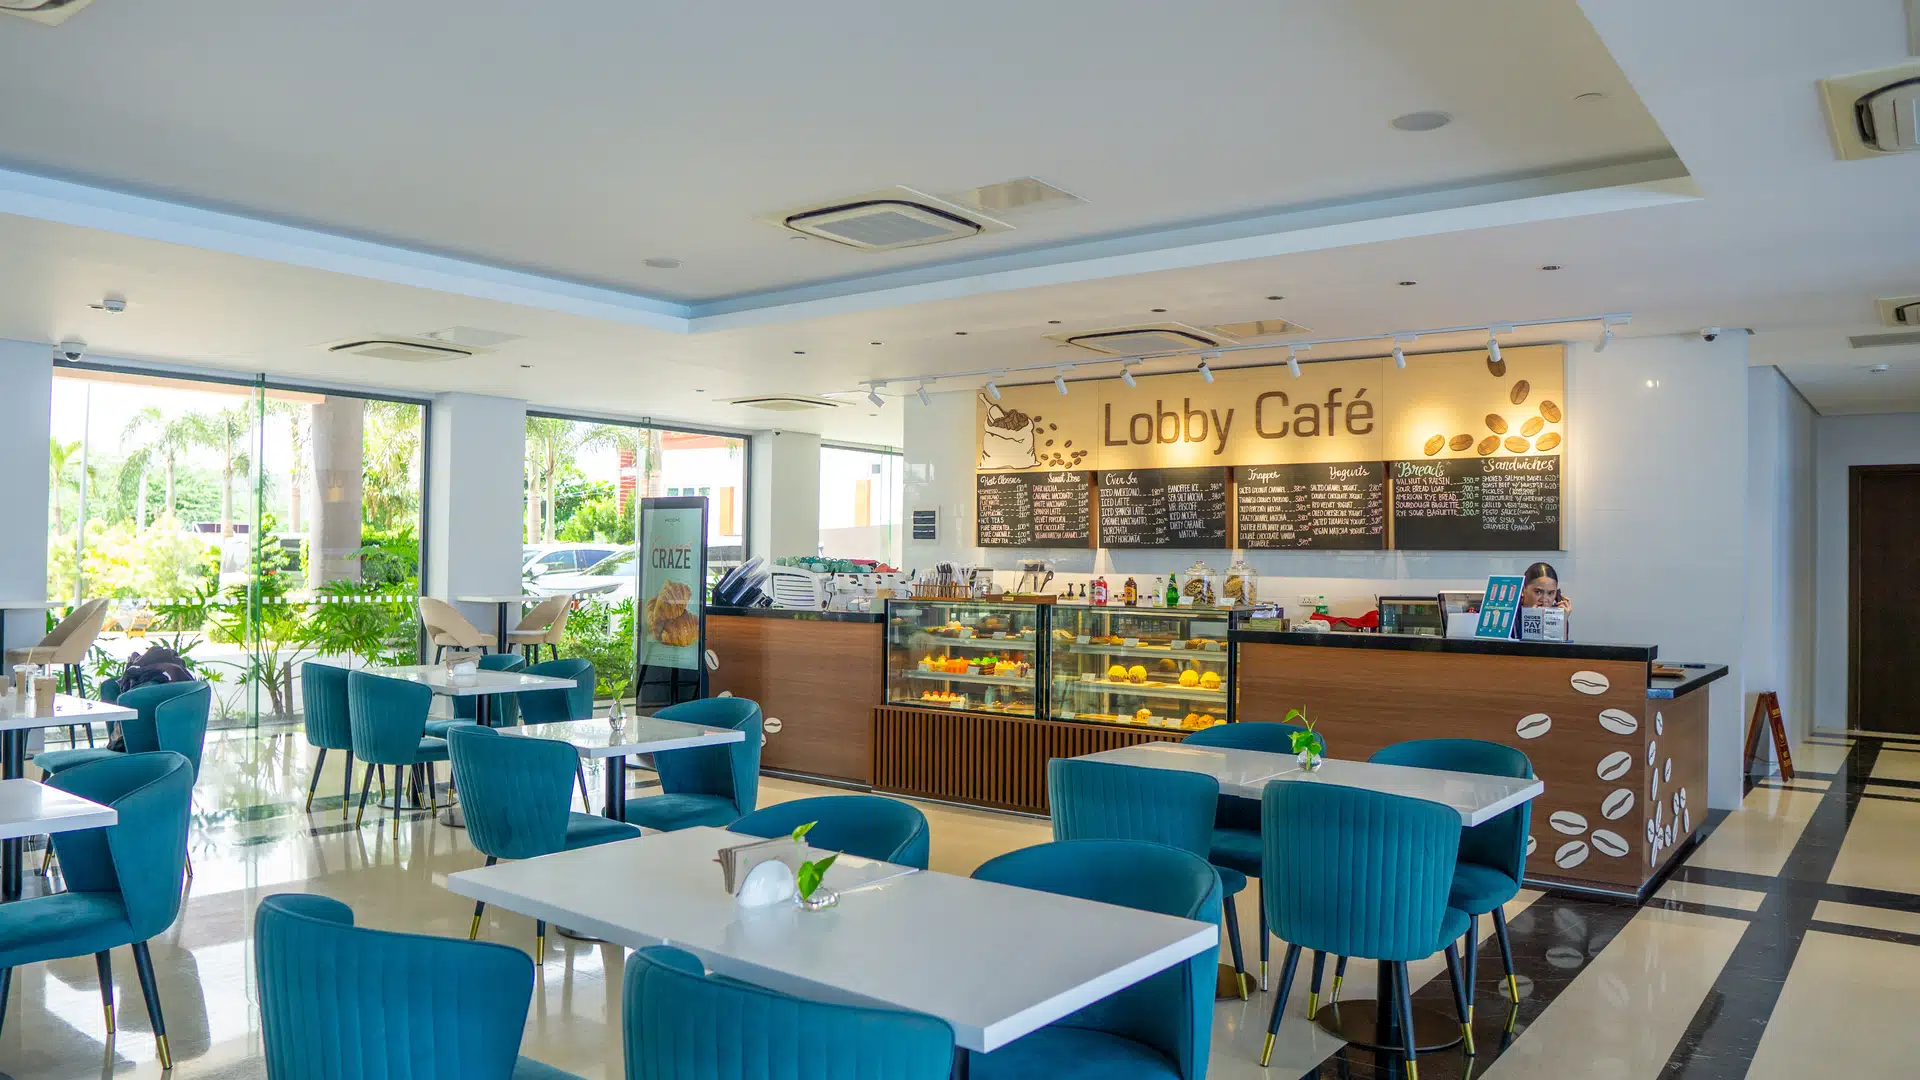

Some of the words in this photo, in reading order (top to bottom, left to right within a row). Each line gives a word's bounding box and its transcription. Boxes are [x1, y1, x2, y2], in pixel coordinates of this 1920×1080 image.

[1104, 398, 1235, 456] Lobby
[1255, 388, 1374, 440] Café
[1397, 461, 1445, 477] Breads
[1483, 457, 1557, 472] Sandwiches
[1329, 465, 1370, 482] Yogurts
[1504, 474, 1526, 482] SALMON
[1396, 477, 1421, 485] WALNUT
[1429, 476, 1450, 485] RAISIN
[1396, 485, 1411, 493] SOUR
[1412, 485, 1429, 493] BREAD
[1431, 485, 1445, 493] LOAF
[1115, 497, 1130, 506] LATTE
[1396, 493, 1422, 501] AMERICAN
[1396, 501, 1430, 509] SOURDOUGH
[1431, 501, 1460, 509] BAGUETTE
[1396, 509, 1407, 517] RYE
[1427, 508, 1458, 517] BAGUETTE
[1482, 523, 1509, 531] GRUYERE
[652, 548, 692, 569] CRAZE
[1524, 621, 1541, 629] PAY
